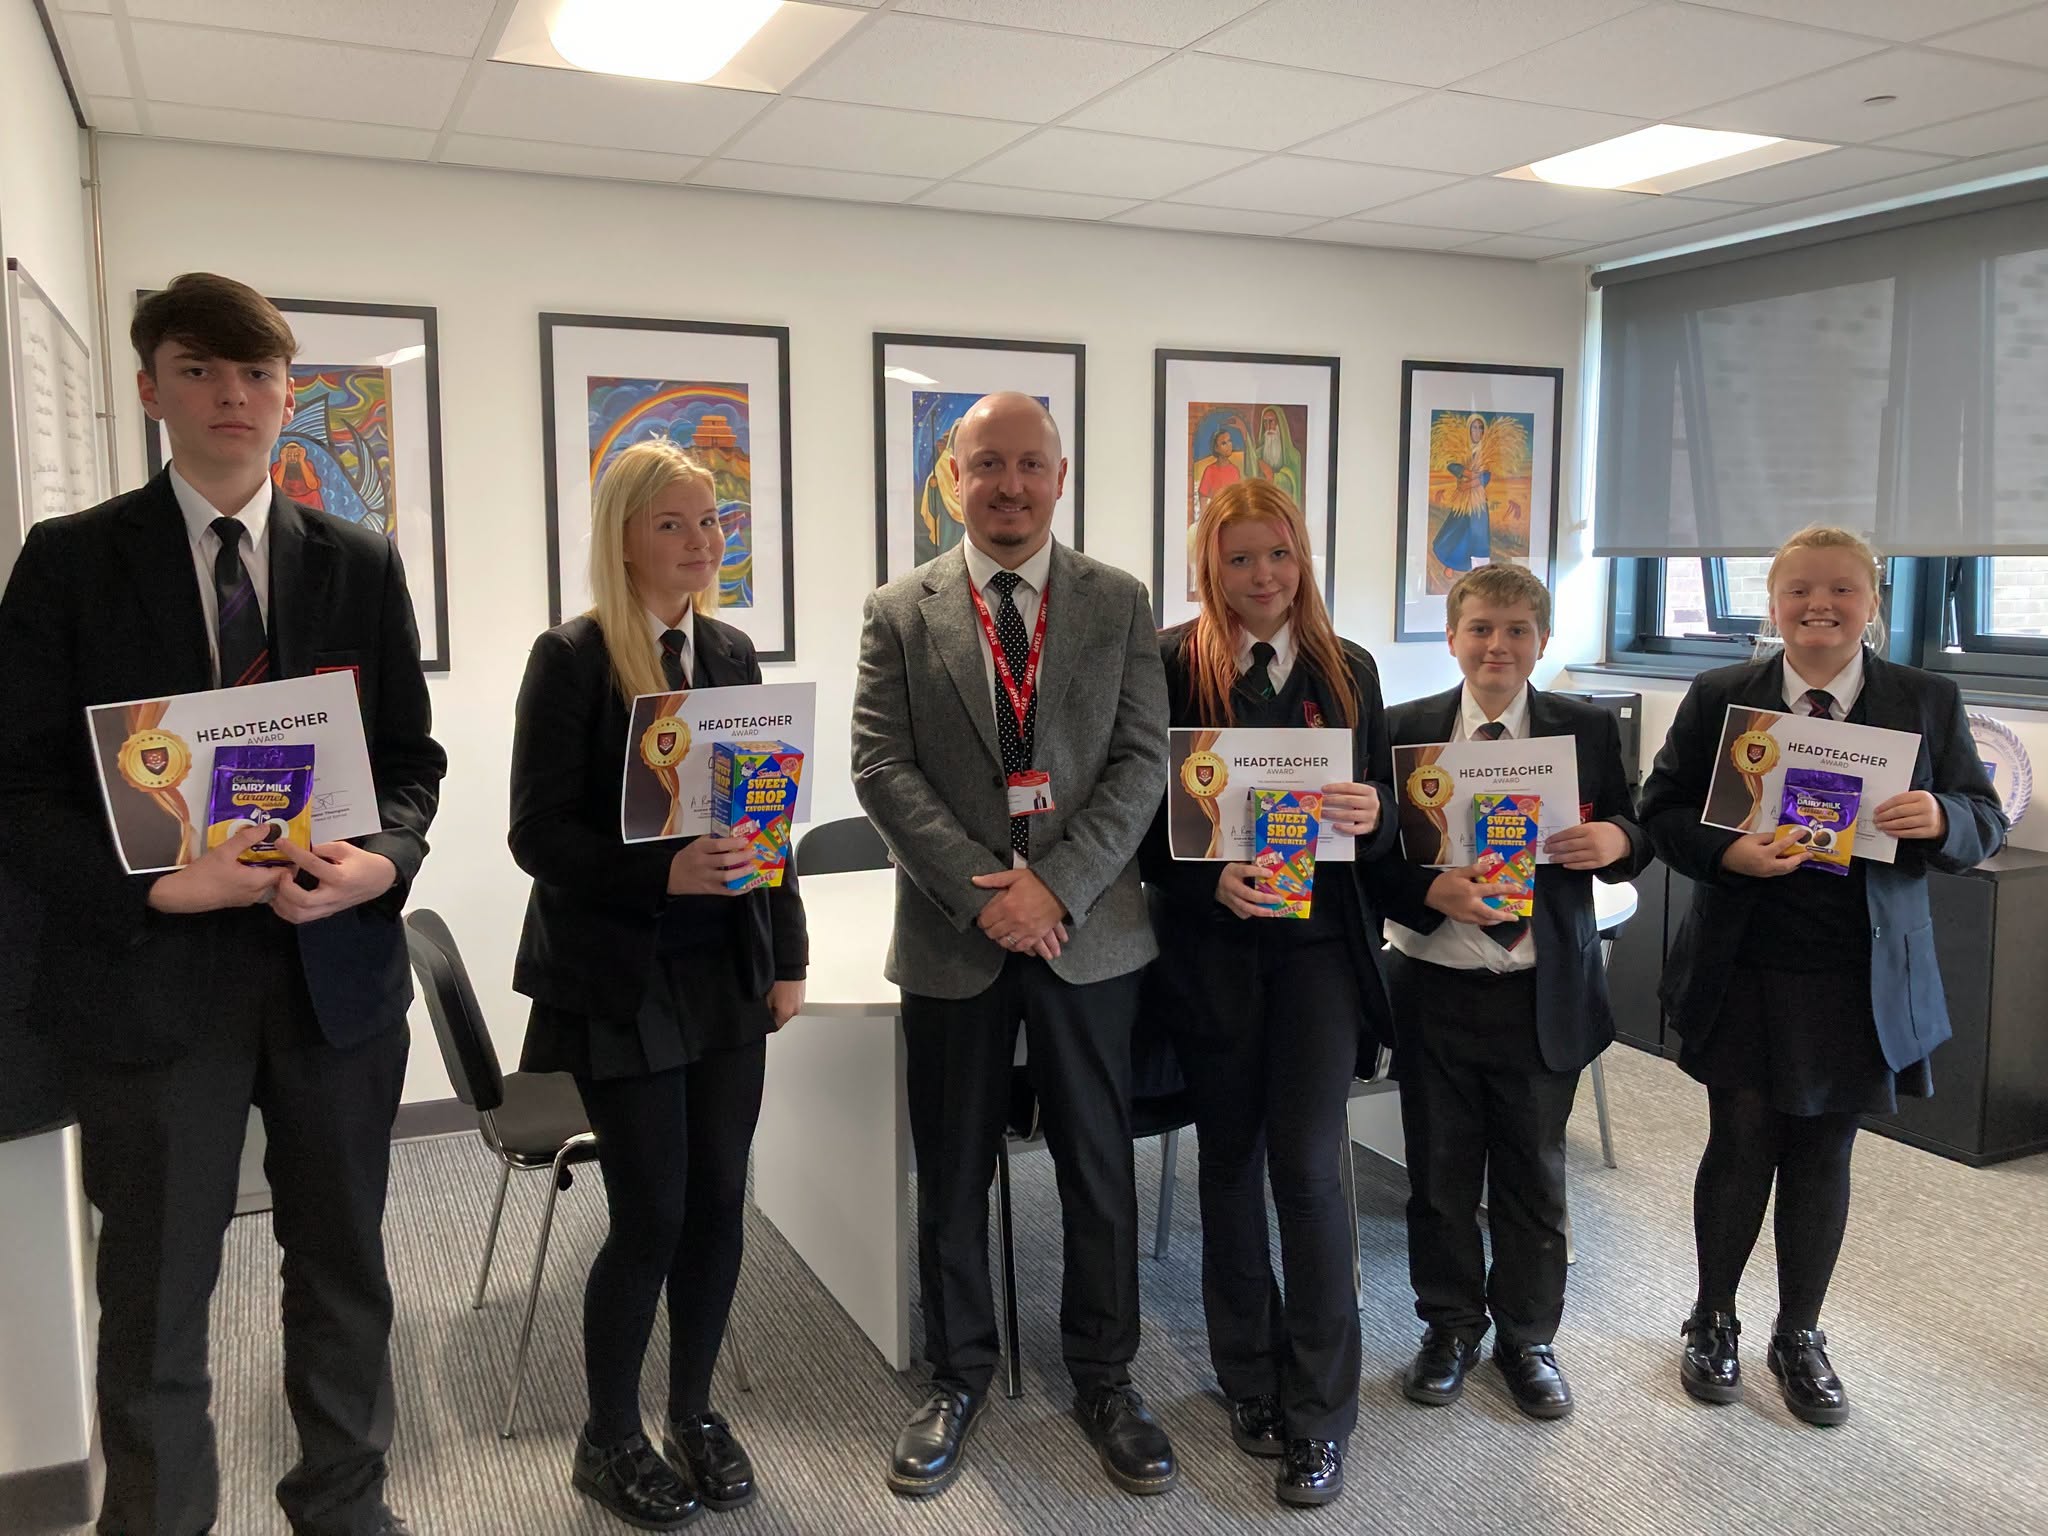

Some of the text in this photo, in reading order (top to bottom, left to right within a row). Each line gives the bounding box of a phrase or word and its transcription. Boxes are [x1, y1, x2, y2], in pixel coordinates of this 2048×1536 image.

[985, 626, 998, 646] STAFF
[1033, 632, 1042, 654] STAFF
[997, 656, 1010, 677] STAFF
[1026, 664, 1035, 686] STAFF
[1009, 687, 1021, 708] STAFF
[196, 711, 328, 743] HEADTEACHER
[698, 715, 793, 731] HEADTEACHER
[247, 733, 285, 745] AWARD
[731, 729, 759, 737] AWARD
[1788, 741, 1888, 768] HEADTEACHER
[1234, 757, 1329, 768] HEADTEACHER
[1819, 758, 1849, 769] AWARD
[1459, 764, 1553, 778] HEADTEACHER
[232, 783, 292, 792] DAIRY MILK
[747, 778, 788, 789] SWEET
[236, 792, 284, 802] Caramel
[746, 790, 787, 804] SHOP
[745, 804, 785, 812] FAVOURITES
[1797, 799, 1841, 810] DAIRY MILK
[1267, 813, 1308, 823] SWEET
[1487, 815, 1527, 826] SWEET
[1267, 824, 1308, 838] SHOP
[1487, 826, 1527, 839] SHOP
[1267, 837, 1307, 846] FAVOURITES
